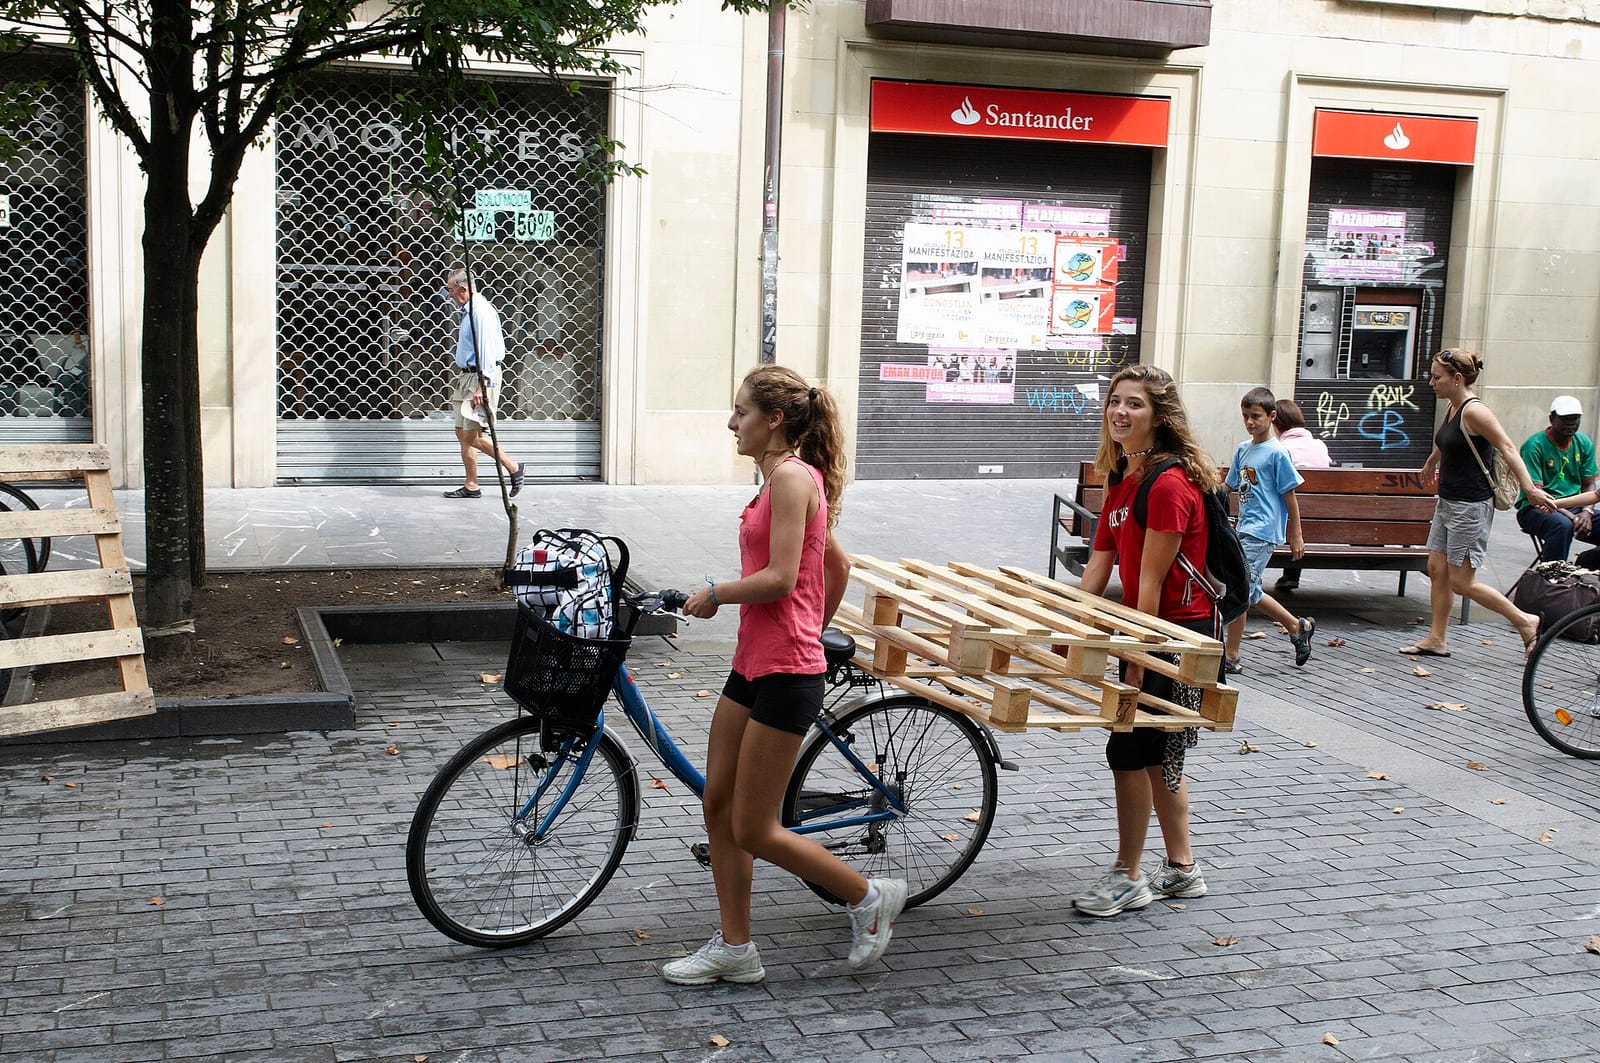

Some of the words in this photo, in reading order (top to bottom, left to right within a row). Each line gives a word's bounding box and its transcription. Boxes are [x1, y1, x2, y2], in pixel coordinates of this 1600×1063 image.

[985, 104, 1093, 131] Santander
[517, 212, 552, 237] 50%
[944, 230, 964, 249] 13
[1019, 236, 1038, 255] 13
[908, 246, 975, 259] MANIFESTAZIOA
[983, 251, 1048, 265] MANIFESTAZIOA
[883, 367, 910, 378] EMAN
